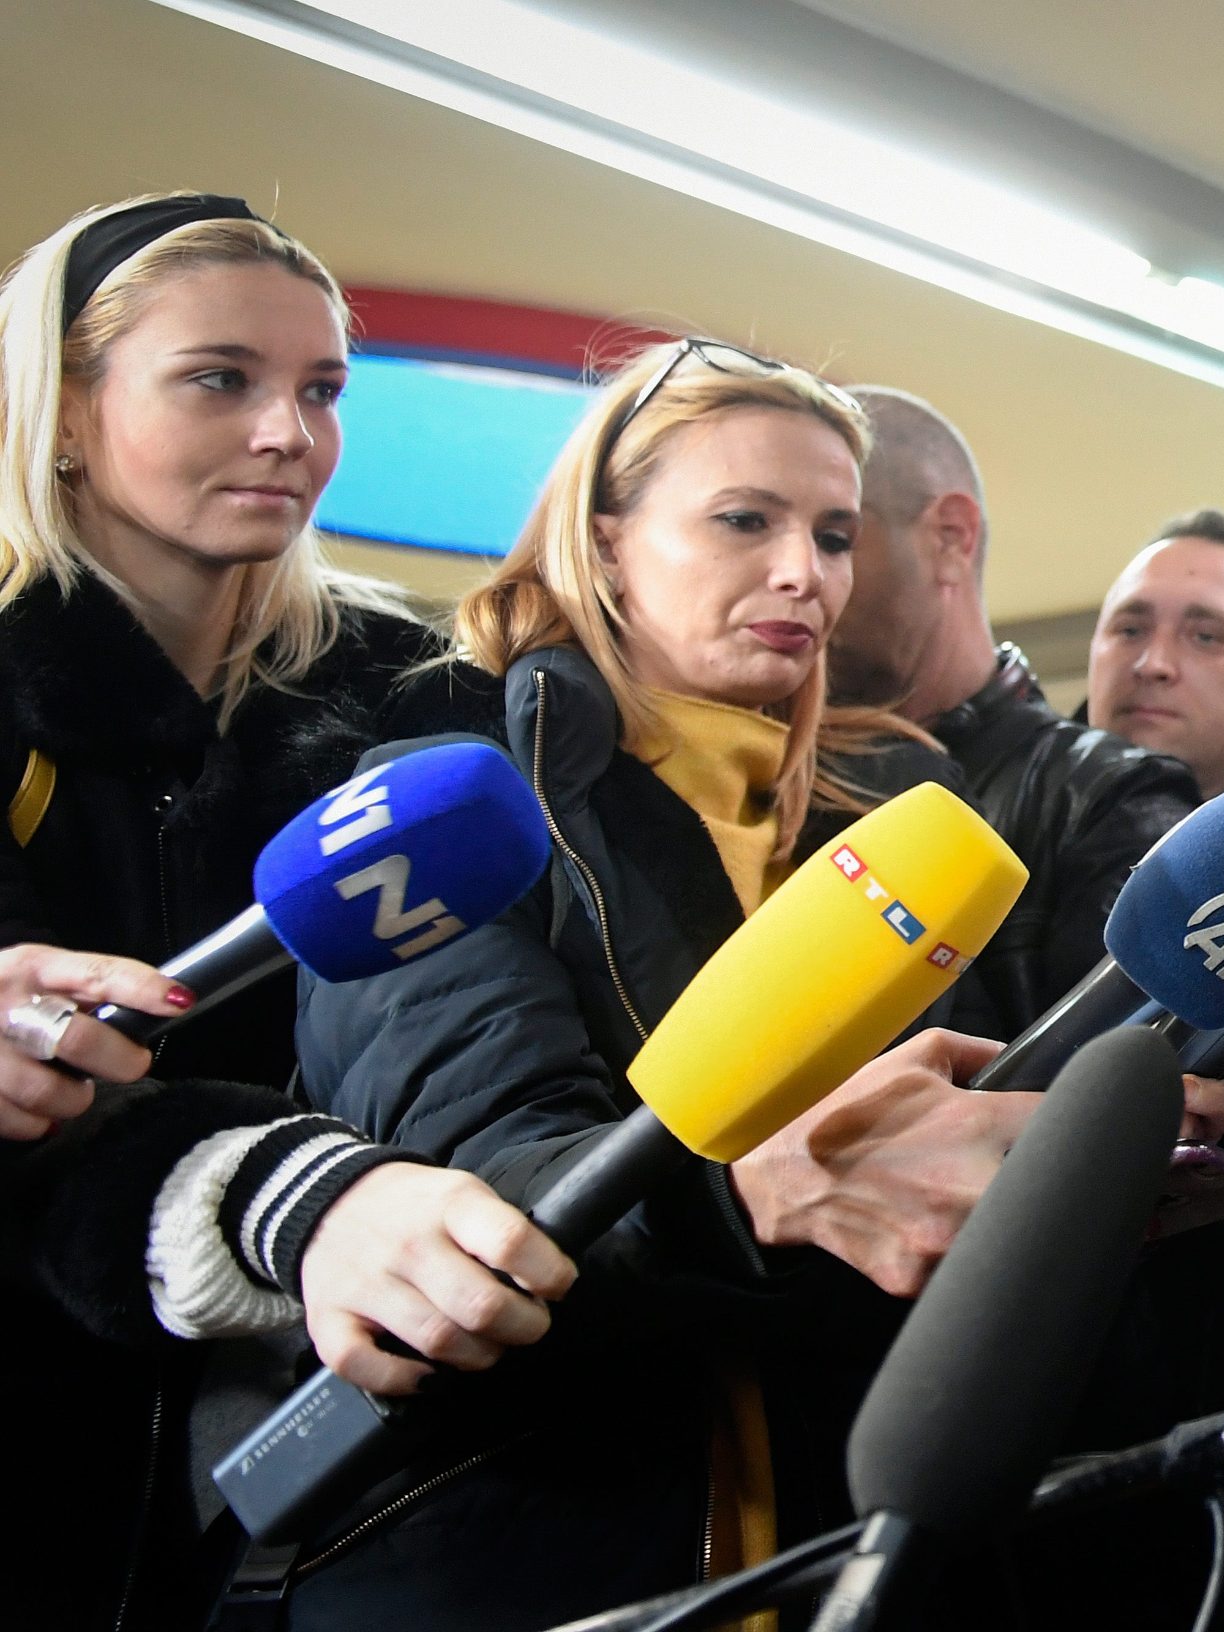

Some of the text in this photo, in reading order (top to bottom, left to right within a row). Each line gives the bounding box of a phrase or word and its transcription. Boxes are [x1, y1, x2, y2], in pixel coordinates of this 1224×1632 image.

[319, 762, 393, 857] N1
[333, 854, 466, 961] N1
[832, 846, 923, 942] RTL
